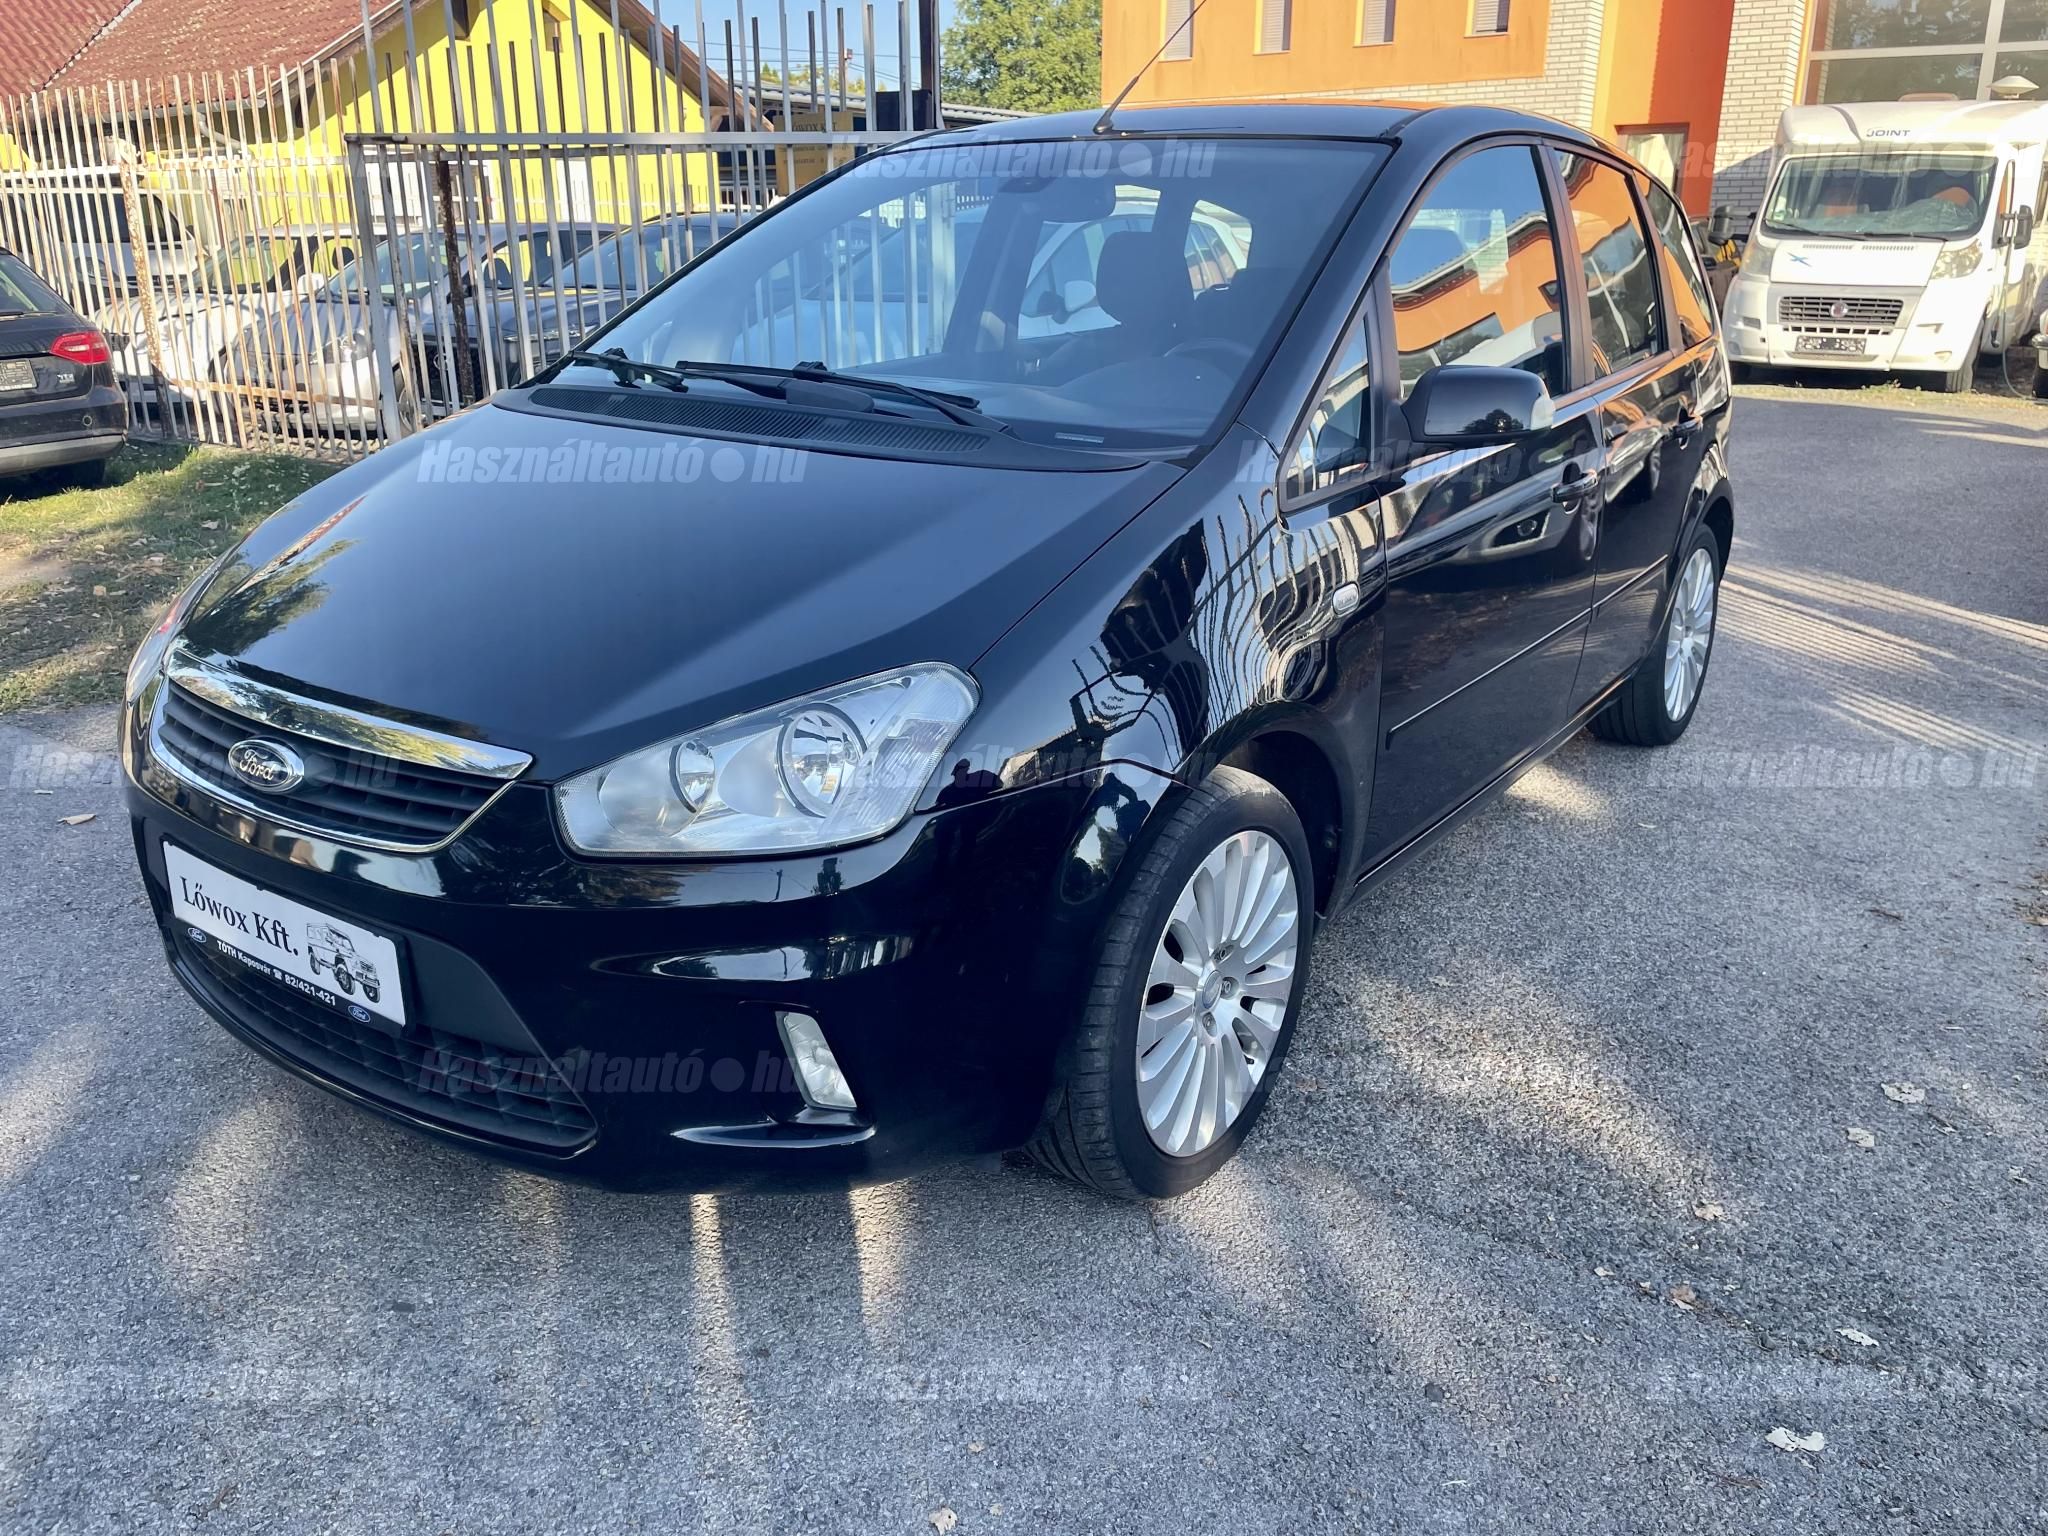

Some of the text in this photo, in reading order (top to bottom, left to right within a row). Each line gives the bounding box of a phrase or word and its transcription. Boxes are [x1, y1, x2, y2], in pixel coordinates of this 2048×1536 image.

[1866, 129, 1911, 137] JOINT
[240, 749, 274, 780] Ford
[180, 876, 299, 957] Lőwox Kft.
[284, 974, 336, 1006] 82/421-421
